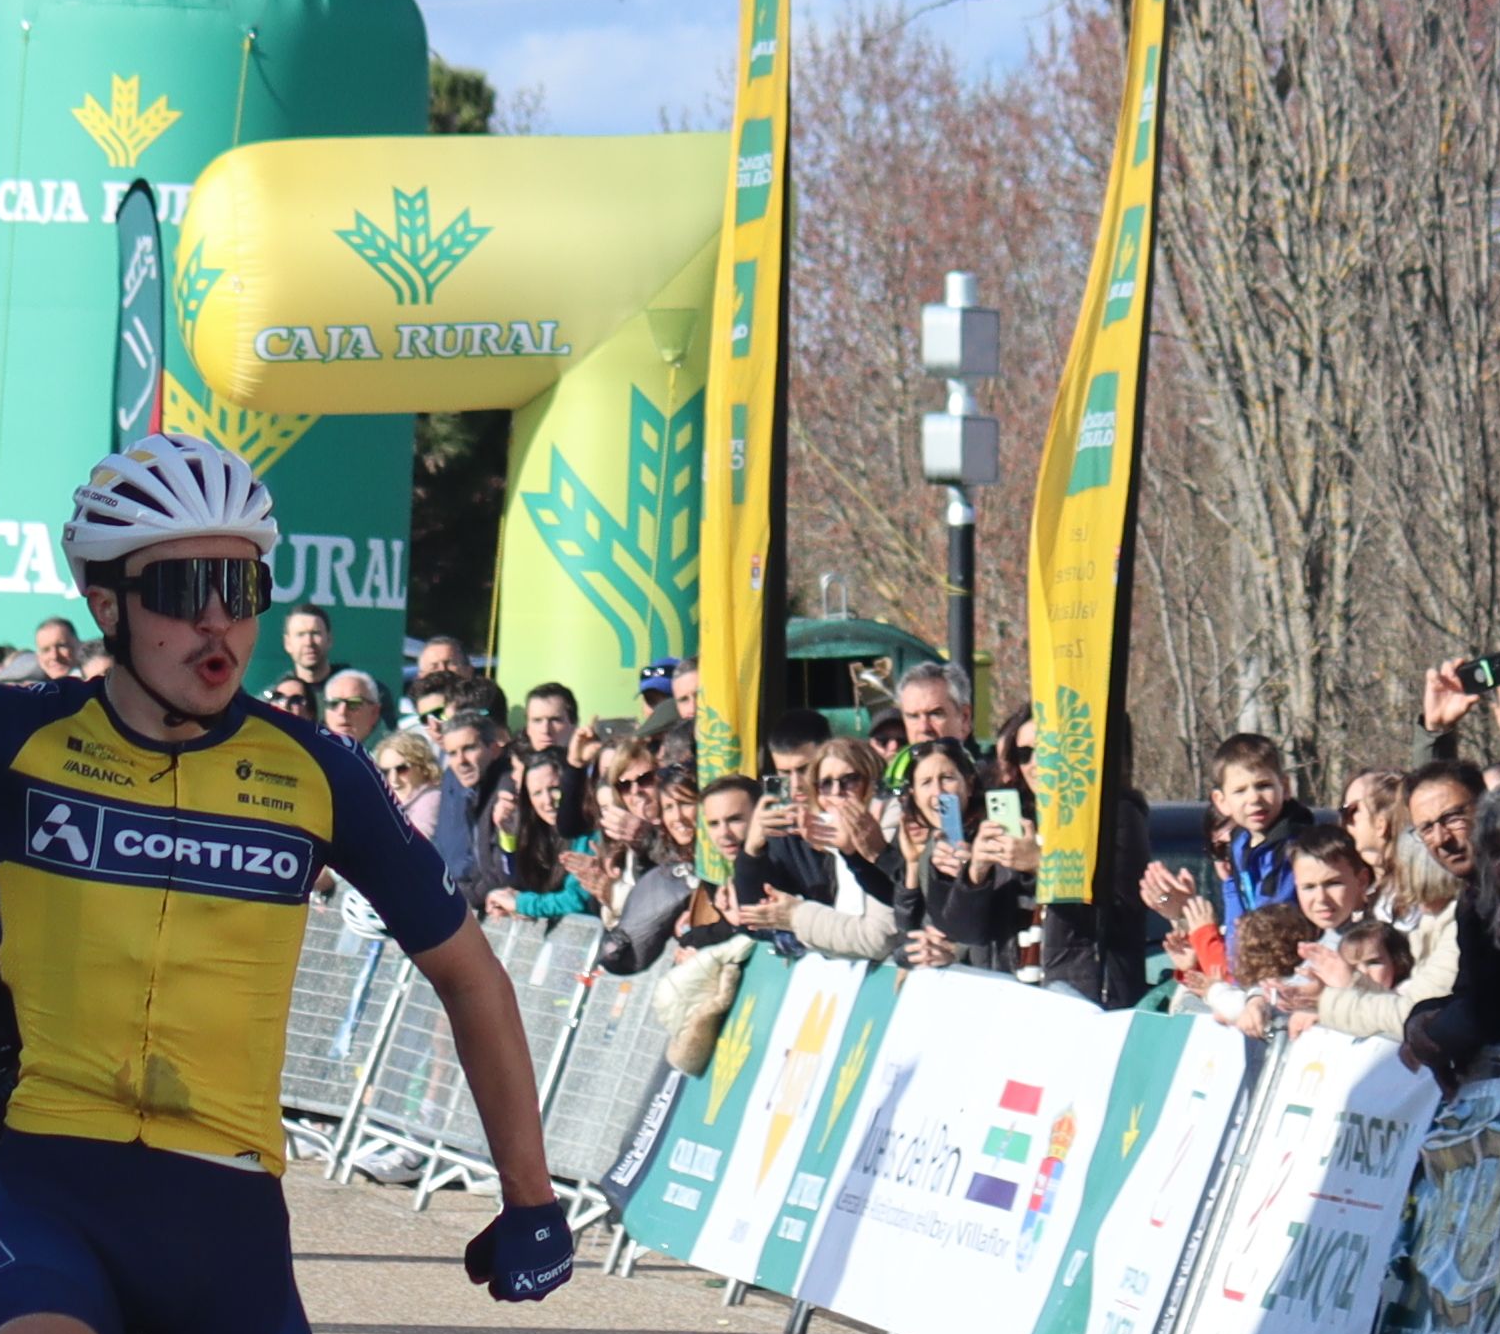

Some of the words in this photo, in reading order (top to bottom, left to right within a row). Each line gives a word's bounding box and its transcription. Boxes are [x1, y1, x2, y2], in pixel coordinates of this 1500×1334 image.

[253, 324, 382, 363] CAJA
[396, 321, 572, 359] RURAL
[268, 533, 408, 610] URAL
[66, 760, 135, 788] ABANCA
[252, 795, 294, 813] LEMA
[113, 828, 300, 881] CORTIZO
